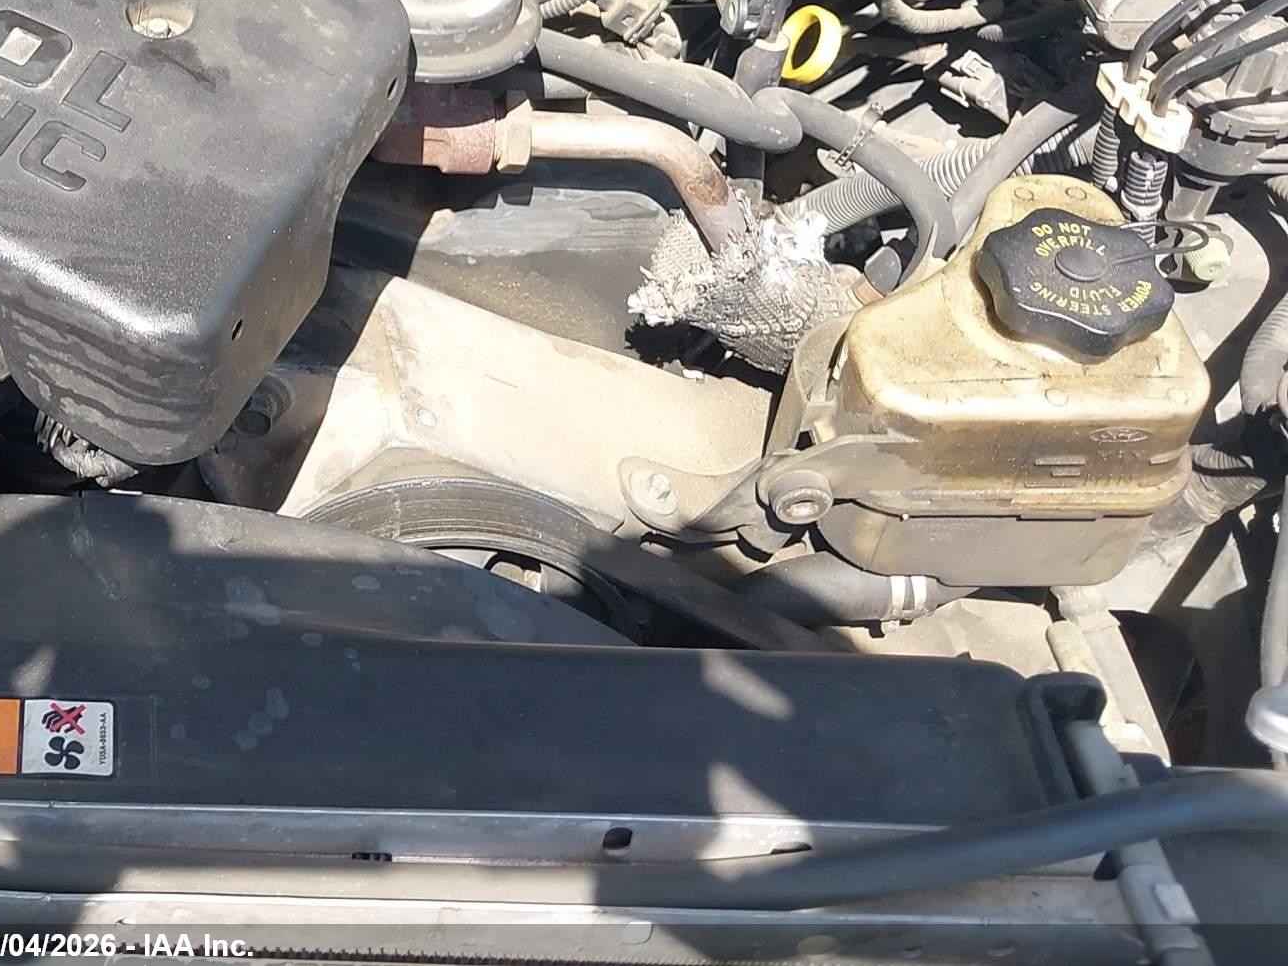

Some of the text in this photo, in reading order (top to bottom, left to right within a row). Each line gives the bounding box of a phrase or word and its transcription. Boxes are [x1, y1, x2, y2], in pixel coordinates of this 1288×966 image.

[1031, 222, 1092, 238] DO NOT
[1034, 234, 1108, 257] OVERFILL
[1030, 280, 1153, 316] POWER STEERING
[1069, 285, 1123, 301] FLUID
